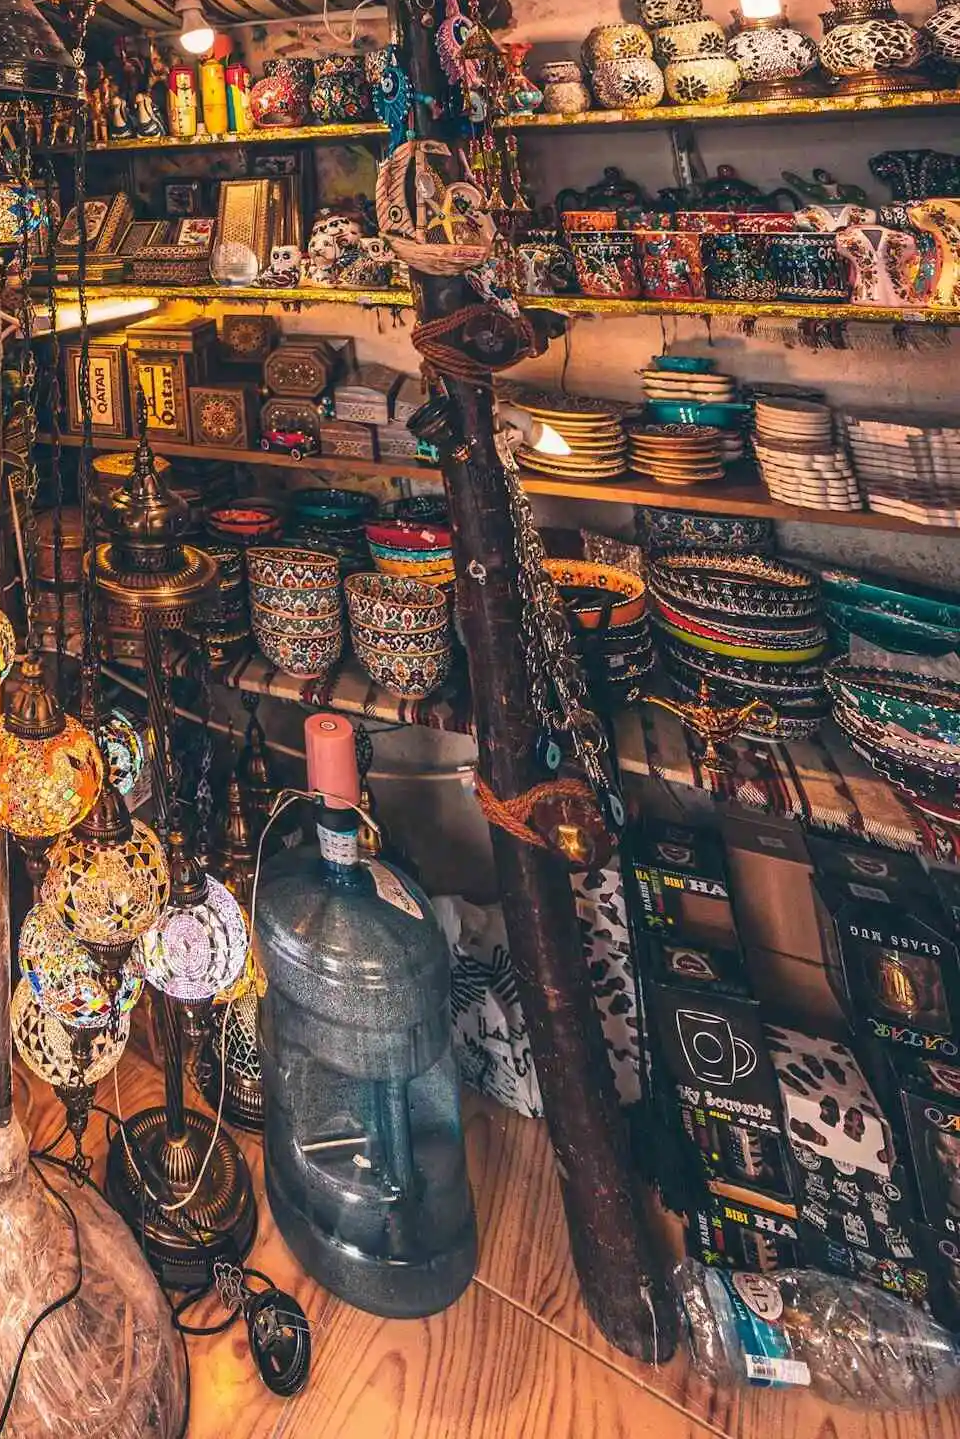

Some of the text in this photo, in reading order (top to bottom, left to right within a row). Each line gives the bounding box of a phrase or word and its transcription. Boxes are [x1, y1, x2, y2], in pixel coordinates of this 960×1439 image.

[95, 367, 108, 414] QATAR
[161, 367, 175, 426] Qatar
[663, 875, 685, 889] BIBI
[849, 925, 941, 956] GLASS MUG
[724, 1207, 750, 1225] BIBI
